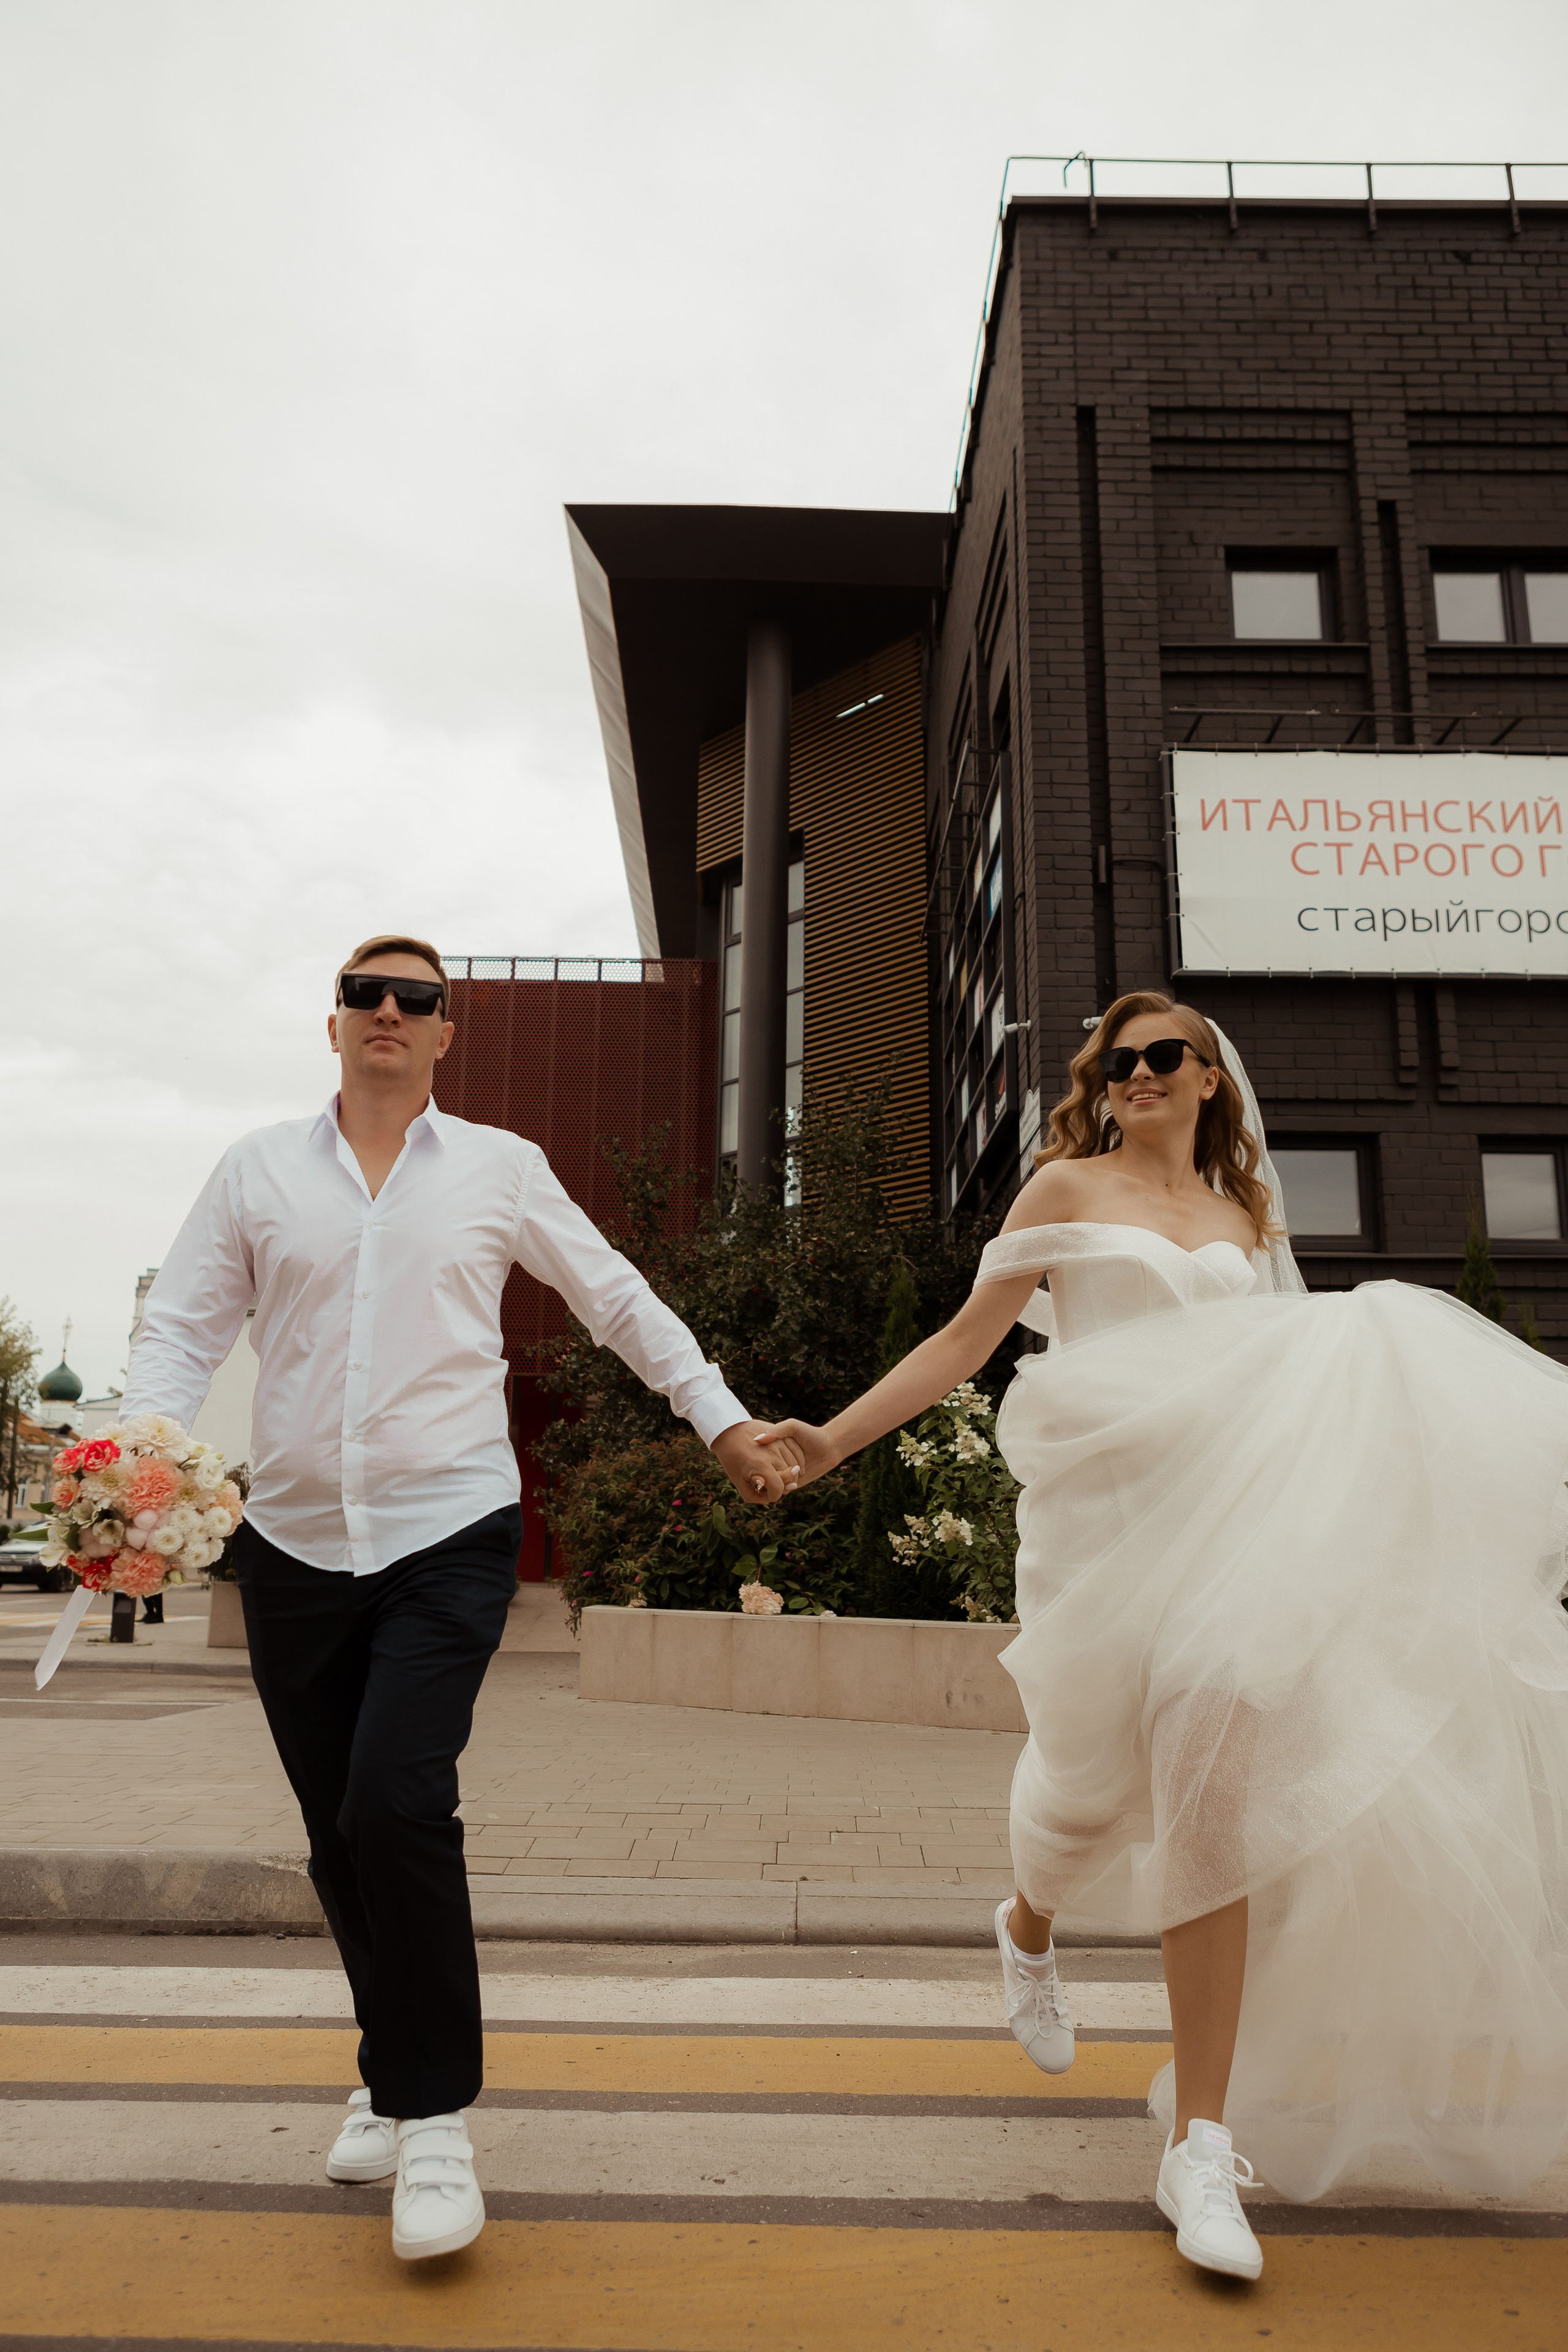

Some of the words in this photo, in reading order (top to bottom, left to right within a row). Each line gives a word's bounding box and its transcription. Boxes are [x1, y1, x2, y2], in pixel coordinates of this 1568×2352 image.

[1200, 796, 1563, 834] ИТАЛЬЯНСКИЙ
[1290, 841, 1524, 878] СТАРОГО
[1538, 844, 1568, 878] Г
